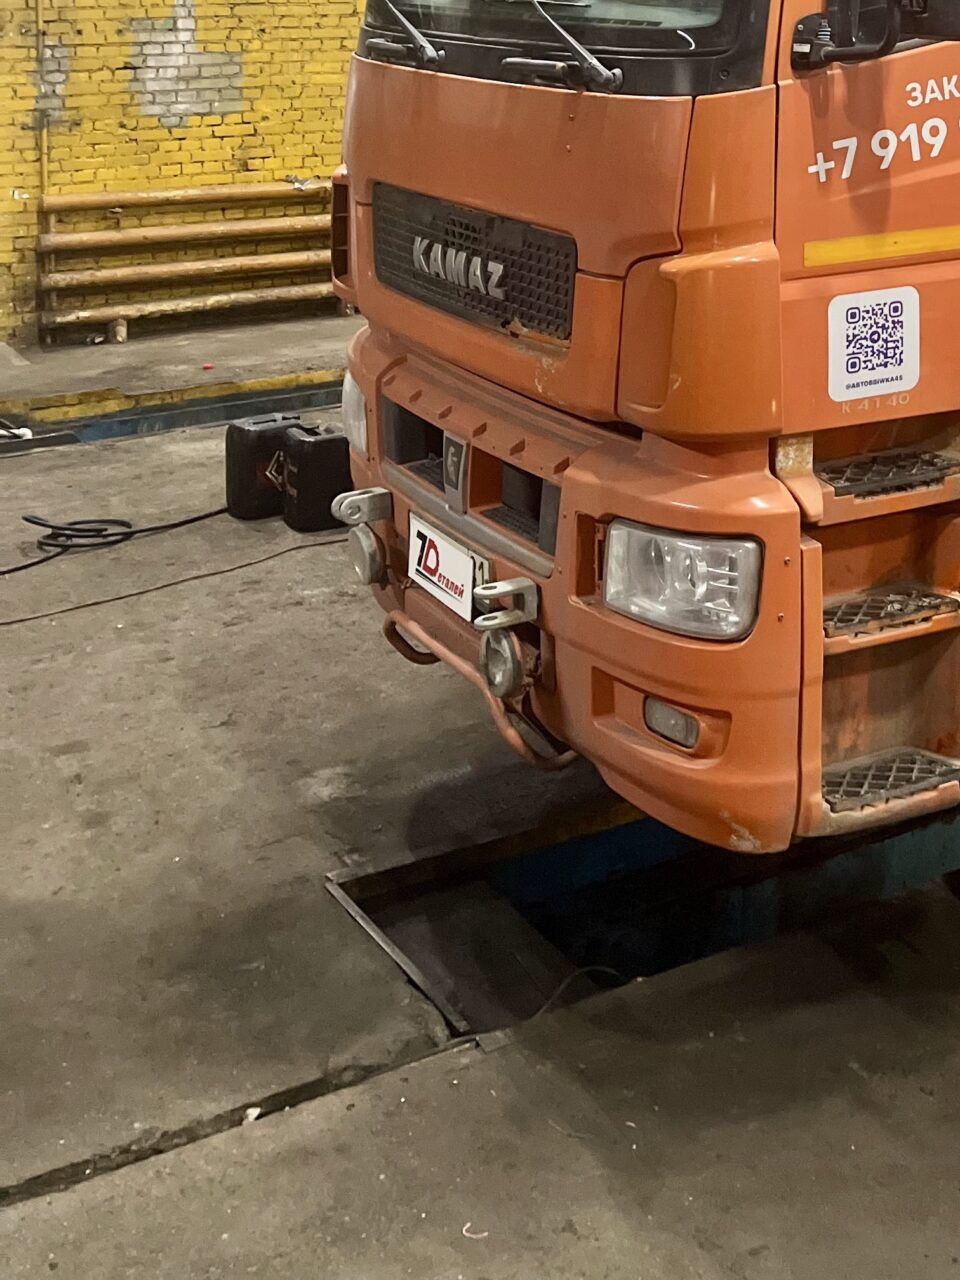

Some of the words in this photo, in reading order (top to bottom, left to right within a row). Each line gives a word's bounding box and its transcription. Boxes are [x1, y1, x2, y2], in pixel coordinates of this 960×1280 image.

[807, 136, 858, 183] +7
[870, 117, 948, 170] 919
[412, 235, 505, 301] KAMAZ
